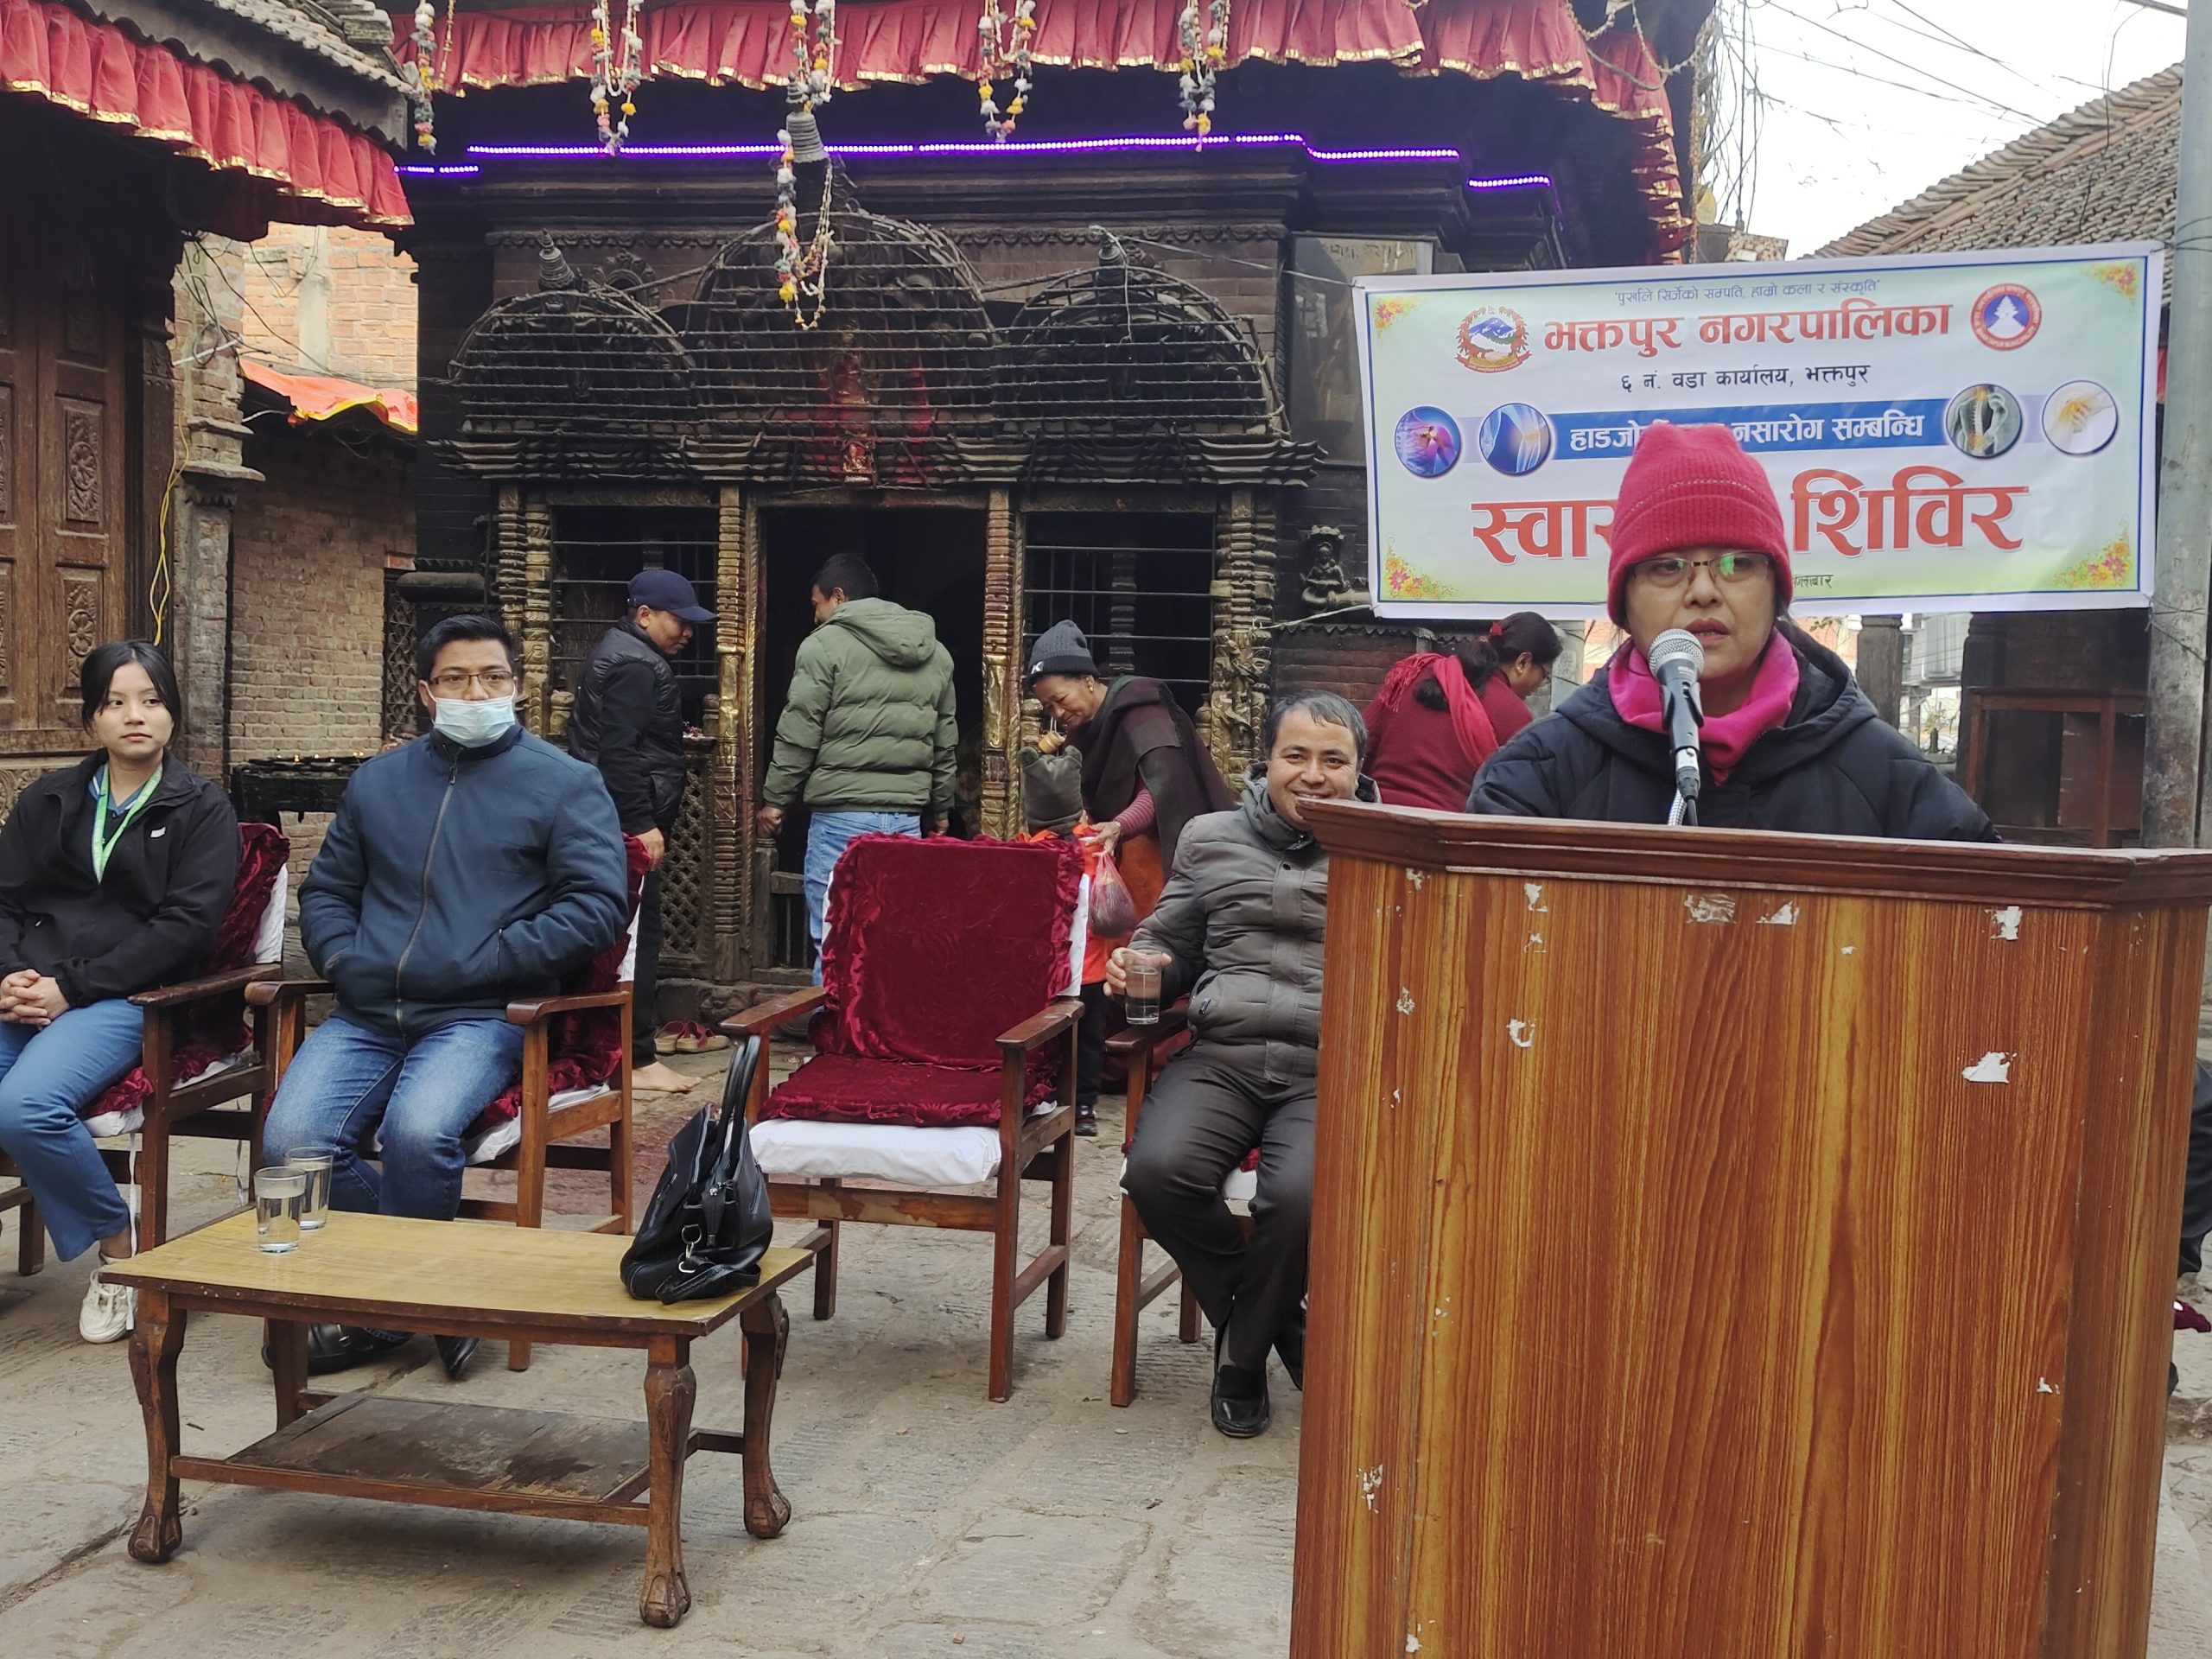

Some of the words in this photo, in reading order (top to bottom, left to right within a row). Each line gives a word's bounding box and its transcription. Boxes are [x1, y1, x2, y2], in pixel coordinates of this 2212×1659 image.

[1783, 283, 1812, 296] कला
[1817, 283, 1825, 294] र
[1544, 316, 1685, 358] भक्तपुर
[1698, 297, 1954, 344] नगरपालिका
[1621, 375, 1632, 392] ६
[1672, 372, 1707, 389] वडा
[1715, 364, 1794, 388] कार्यालय,
[1805, 365, 1871, 387] भक्तपुर
[1731, 413, 1825, 444] नसारोग
[1832, 409, 1925, 442] सम्बन्धि
[1791, 466, 2029, 556] शिविर
